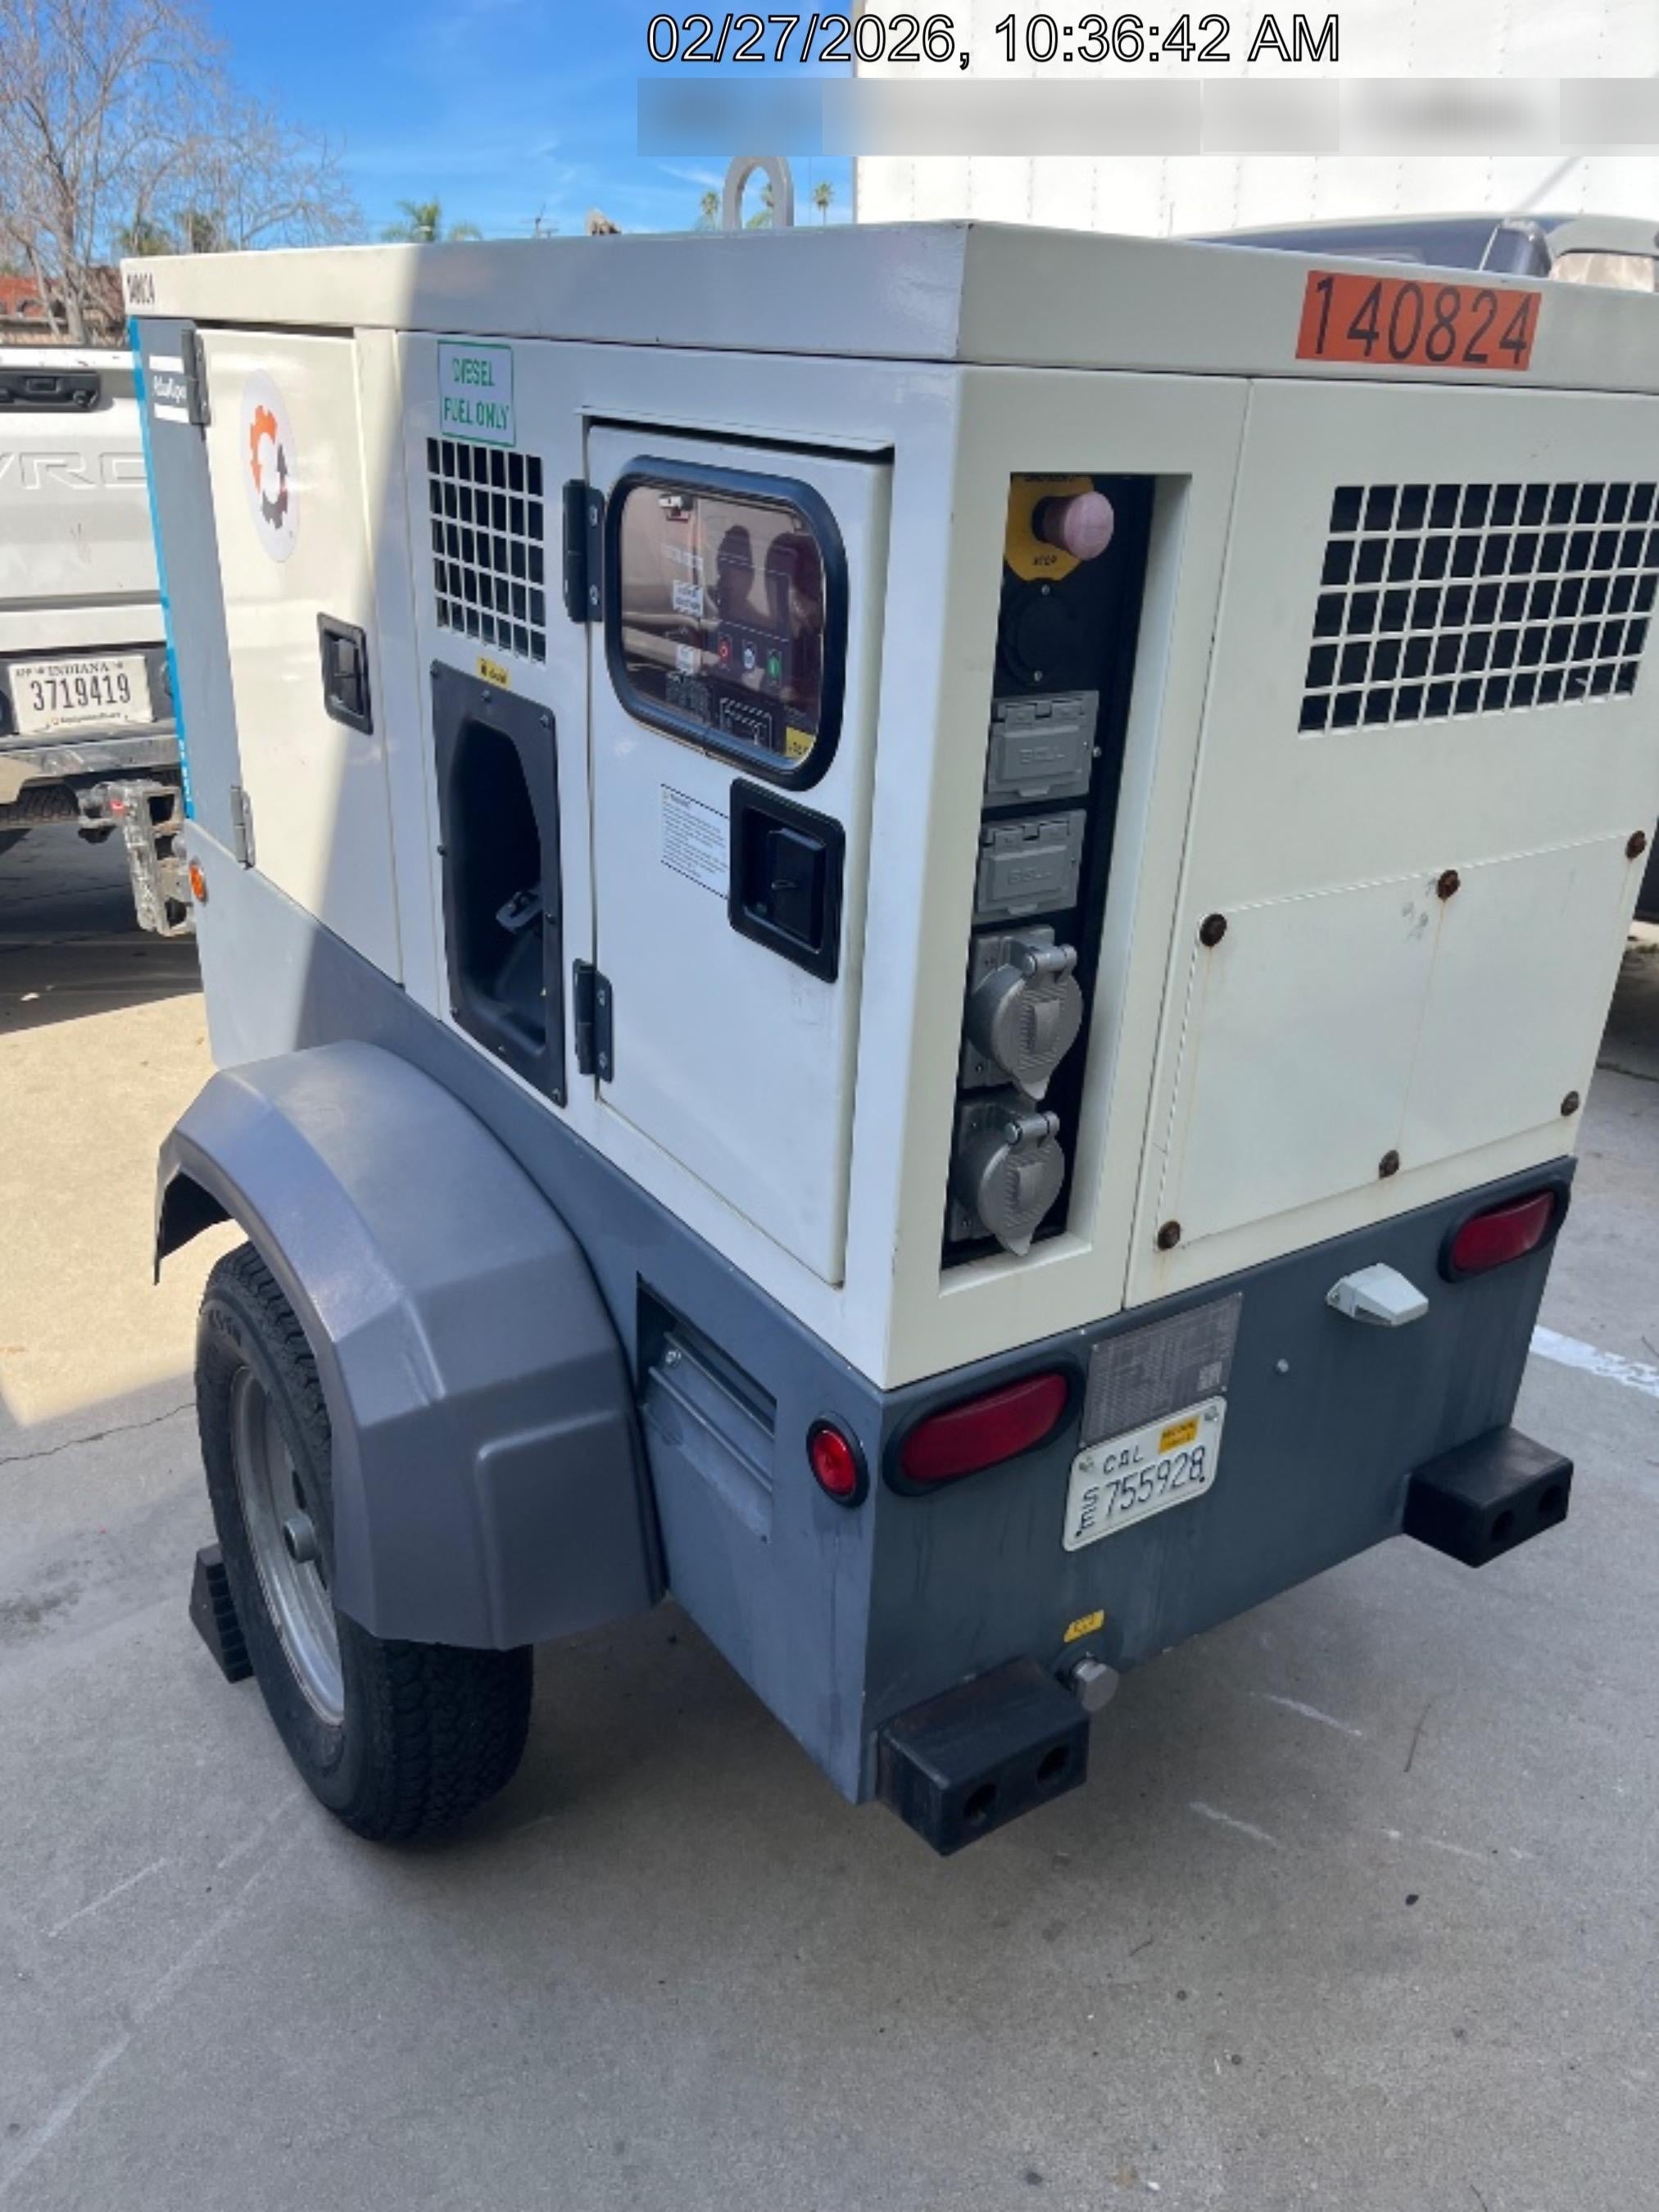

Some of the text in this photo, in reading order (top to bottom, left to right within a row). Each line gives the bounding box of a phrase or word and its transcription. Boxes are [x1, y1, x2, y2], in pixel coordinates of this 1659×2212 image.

[1315, 275, 1533, 365] 140824
[452, 357, 495, 387] DIESEL
[444, 397, 510, 431] FUEL ONLY
[48, 661, 110, 677] INDIANA
[30, 673, 131, 711] 3719419
[1103, 1444, 1144, 1475] CAL
[1105, 1444, 1206, 1516] 755928
